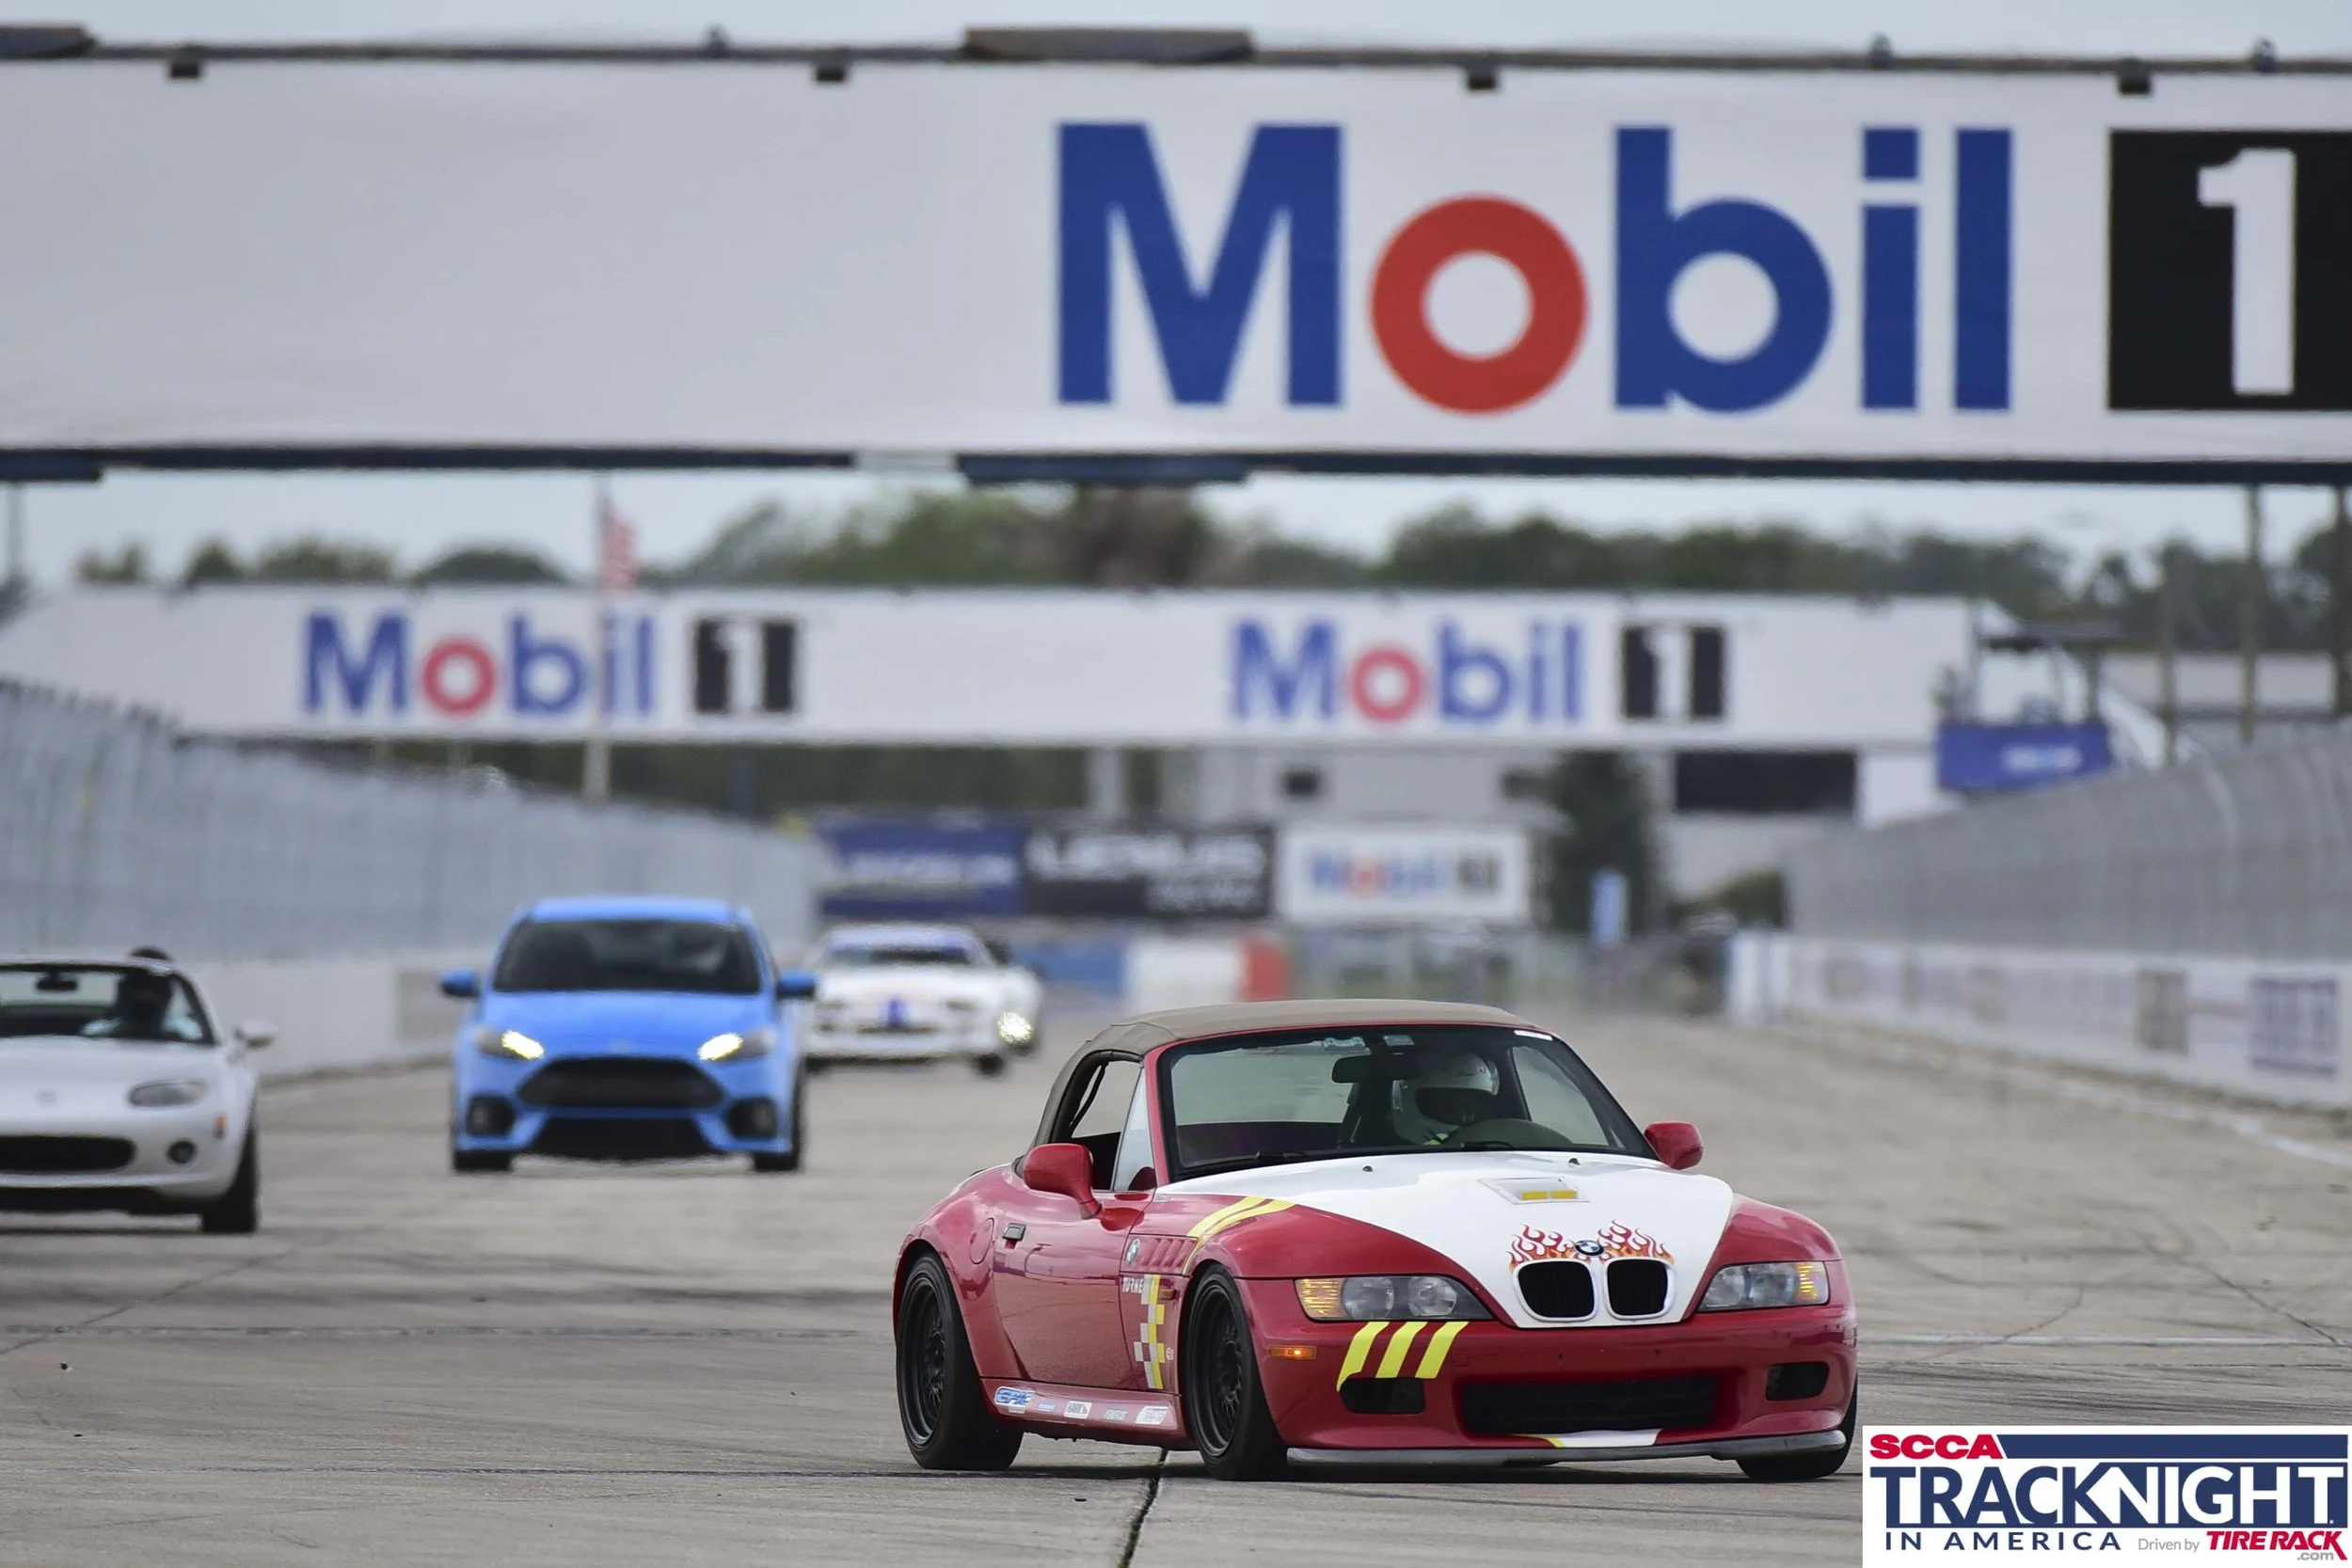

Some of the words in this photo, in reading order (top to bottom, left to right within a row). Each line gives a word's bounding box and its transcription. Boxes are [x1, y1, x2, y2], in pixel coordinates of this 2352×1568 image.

[1057, 123, 2011, 413] Mobil
[2198, 150, 2295, 394] 1
[304, 613, 657, 718] Mobil
[1233, 623, 1583, 722] Mobil
